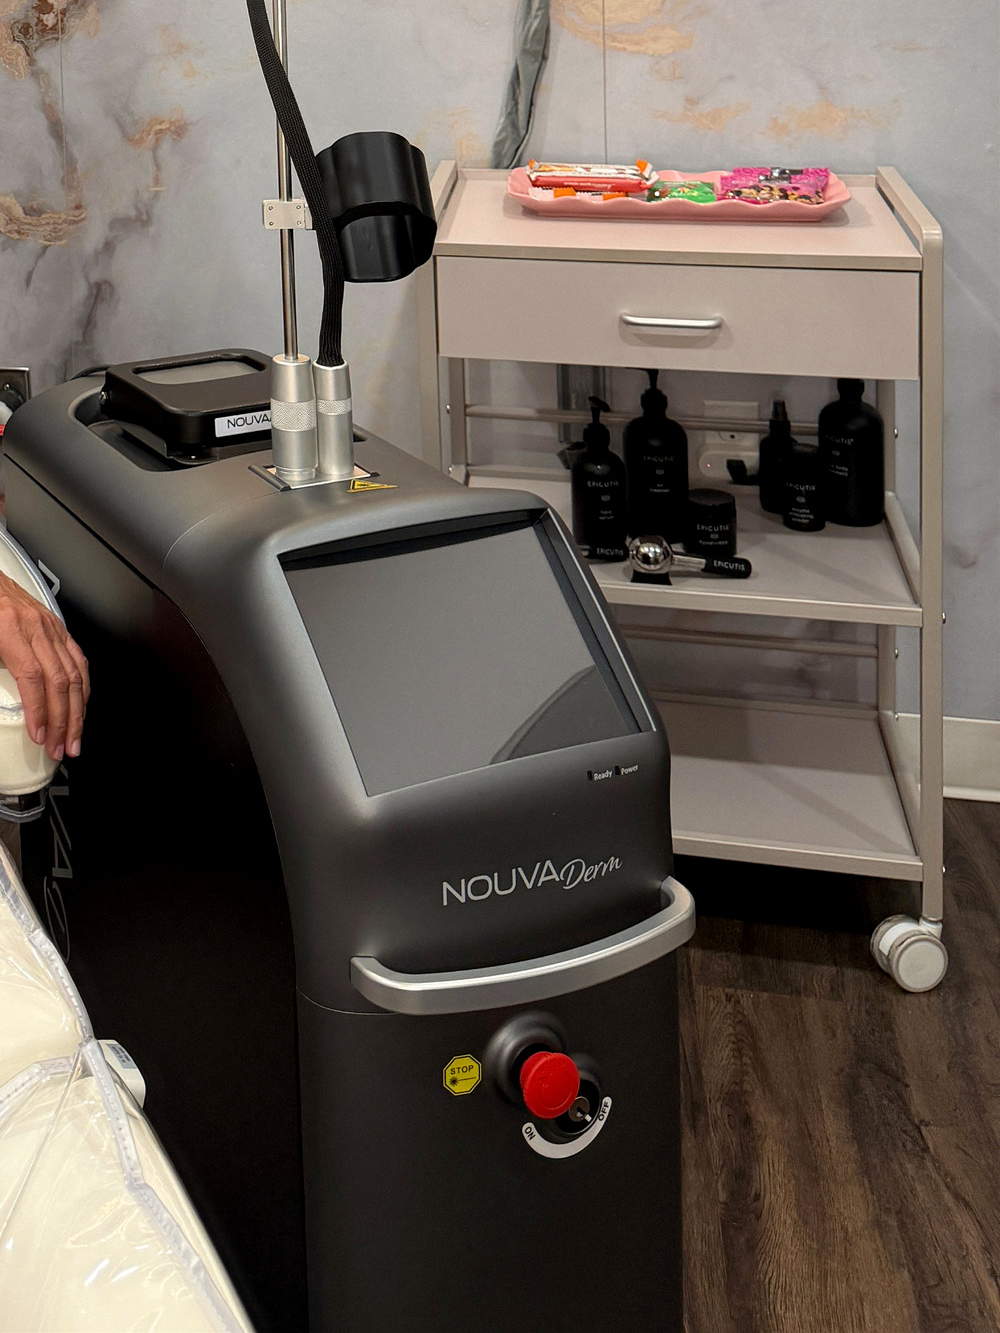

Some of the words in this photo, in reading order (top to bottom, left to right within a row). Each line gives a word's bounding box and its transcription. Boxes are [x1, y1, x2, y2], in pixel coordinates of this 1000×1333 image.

[228, 413, 272, 429] NOUVA
[713, 559, 746, 571] EPICUTIS
[593, 769, 613, 781] Ready
[621, 764, 639, 775] Power
[450, 1065, 474, 1075] STOP
[598, 1101, 610, 1122] OFF
[524, 1126, 536, 1141] ON
